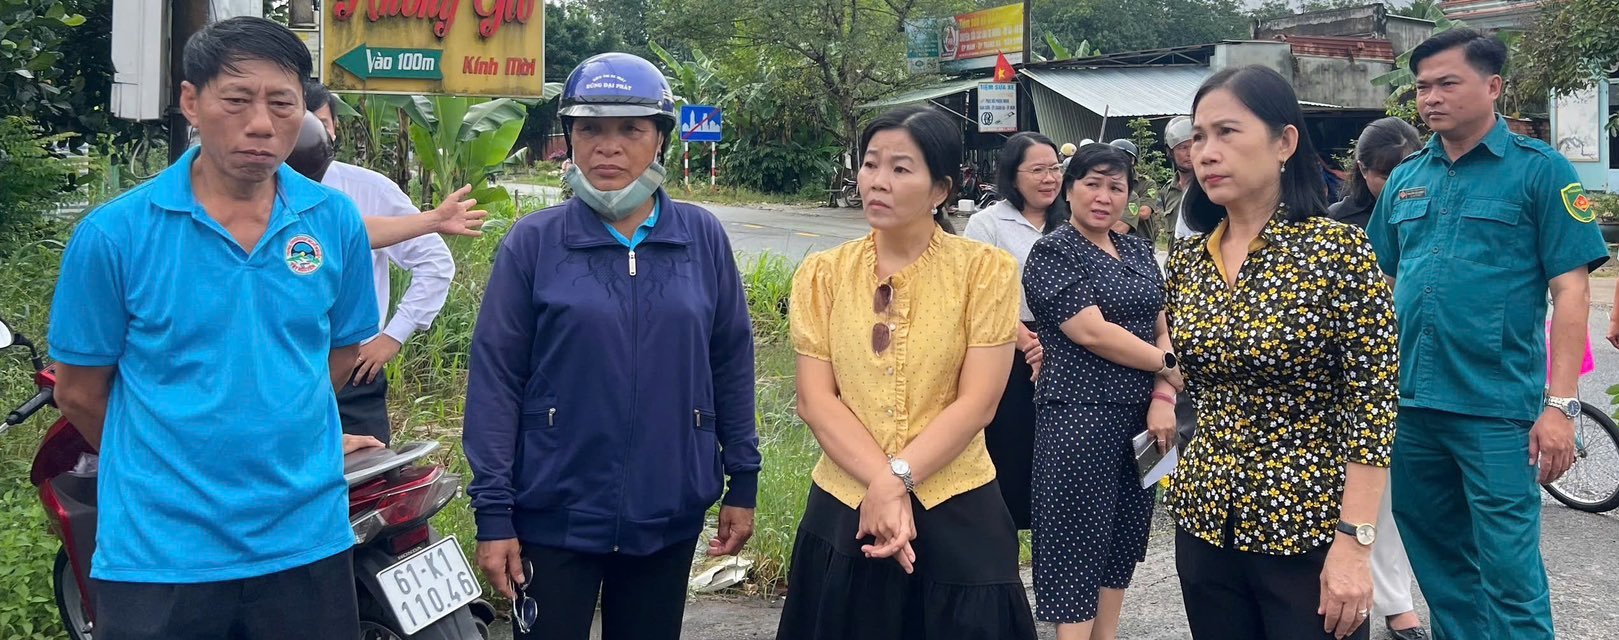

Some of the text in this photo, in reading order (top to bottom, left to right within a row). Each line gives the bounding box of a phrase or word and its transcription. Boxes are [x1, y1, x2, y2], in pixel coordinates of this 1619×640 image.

[366, 48, 435, 74] Vào 100m
[462, 56, 499, 75] Kính
[393, 547, 453, 595] 61-K1
[401, 571, 474, 627] 110.46
